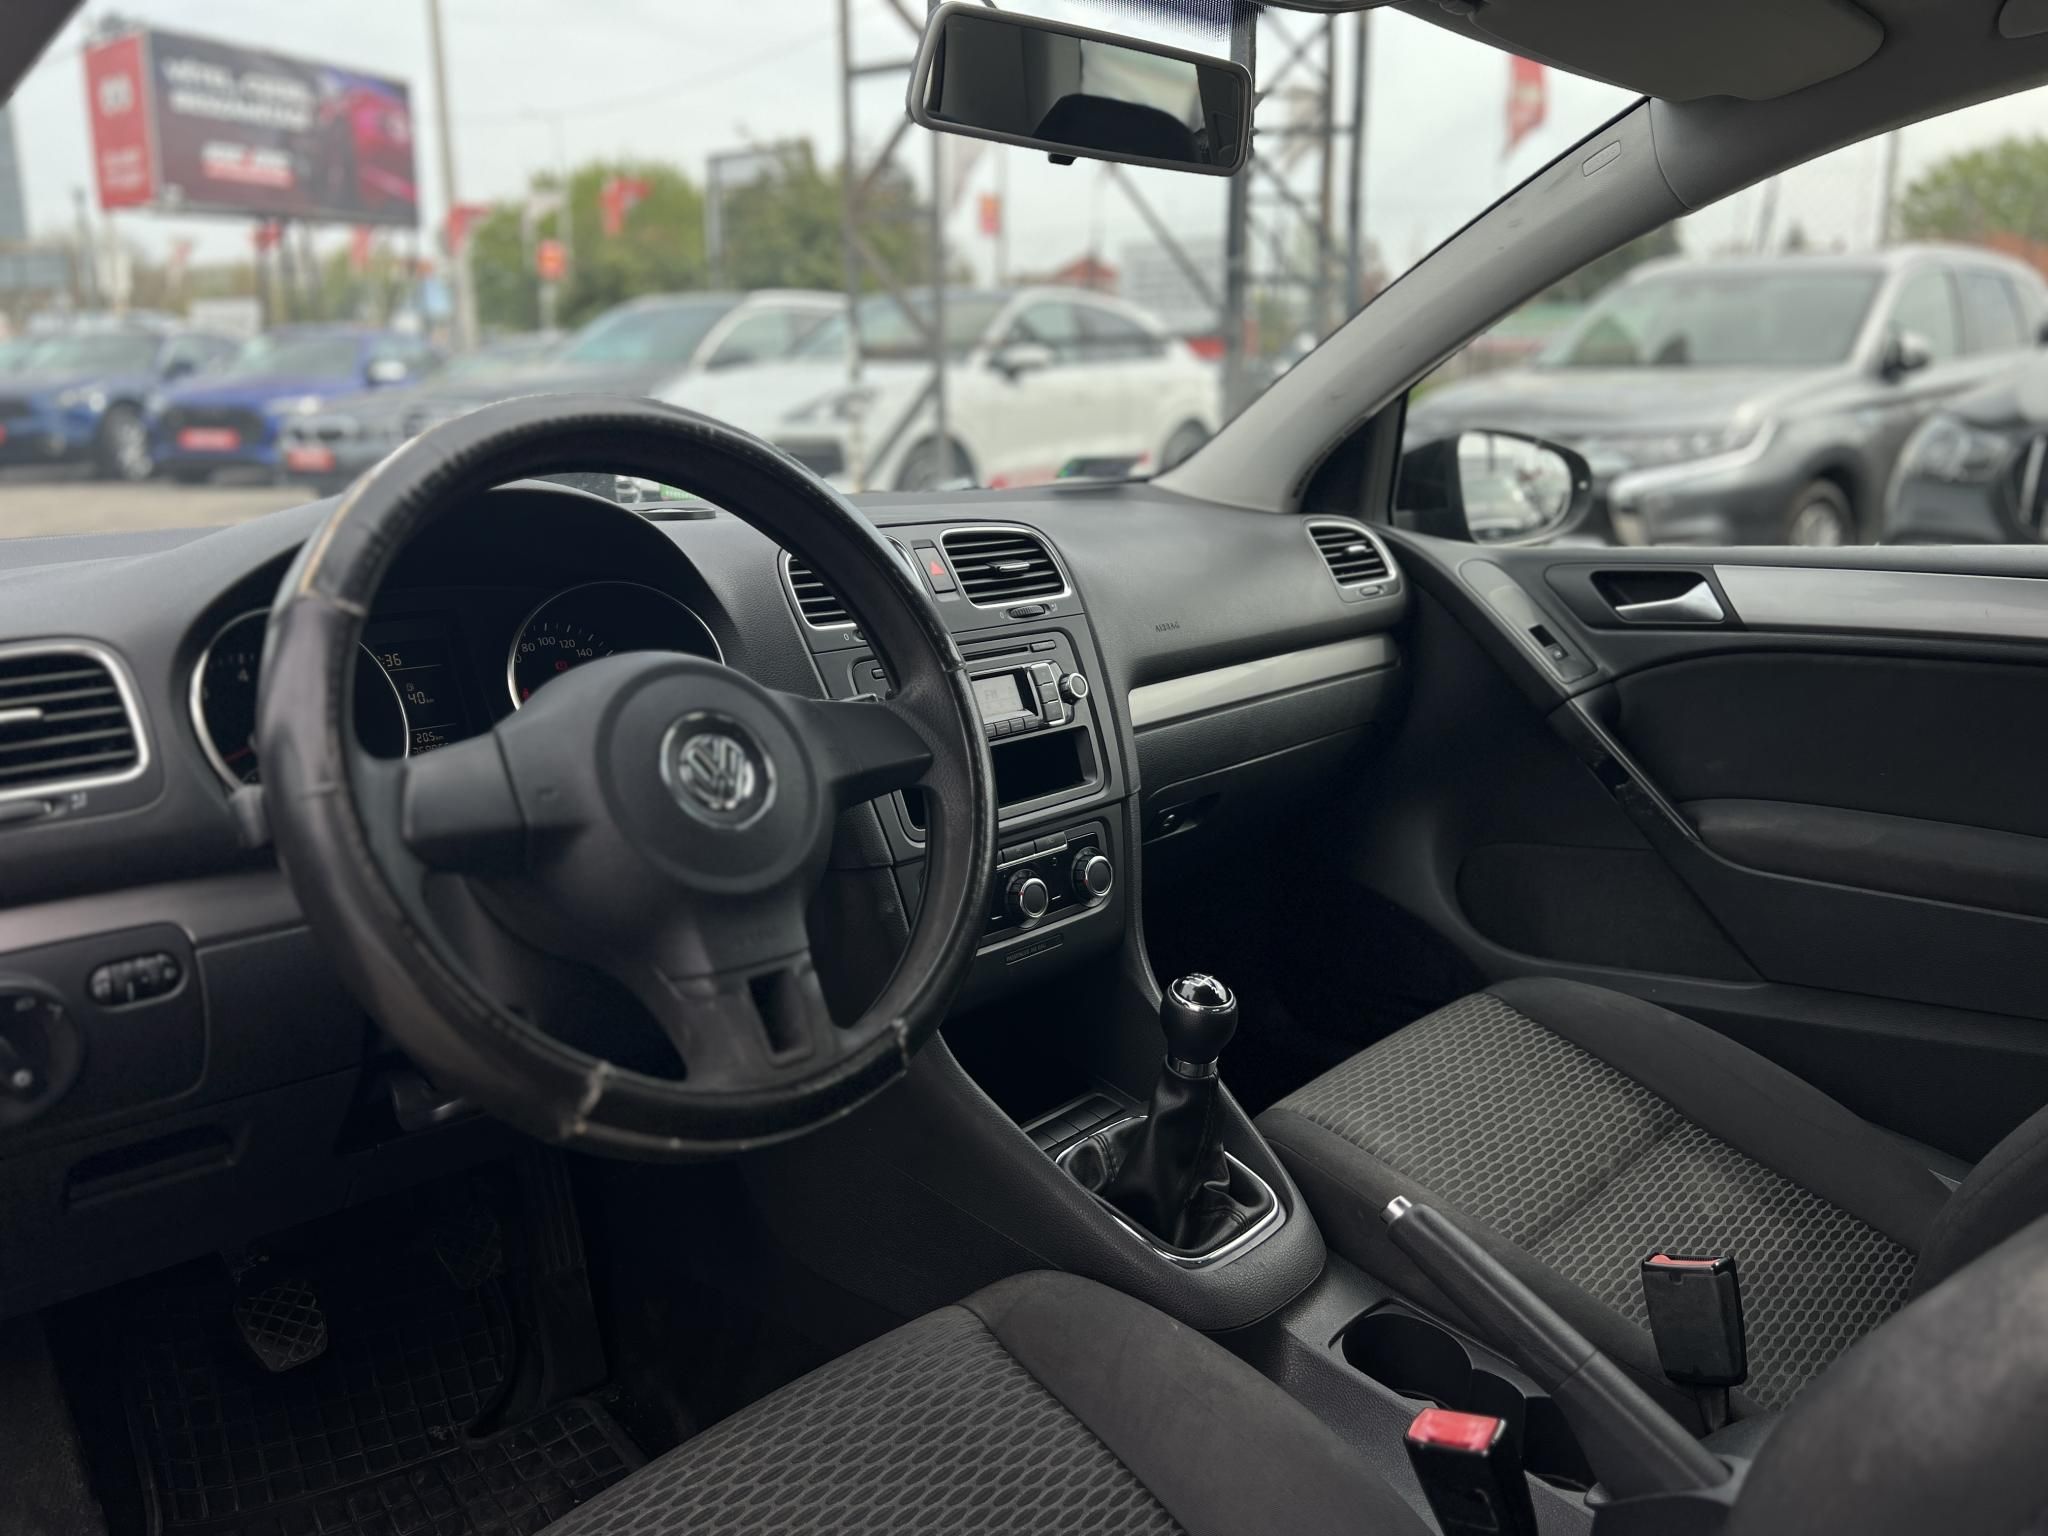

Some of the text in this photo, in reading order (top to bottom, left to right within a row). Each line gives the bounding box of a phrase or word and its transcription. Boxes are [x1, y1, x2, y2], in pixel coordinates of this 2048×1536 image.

[844, 633, 850, 641] 0
[521, 642, 536, 652] 80
[537, 636, 556, 646] 100
[559, 639, 576, 649] 120
[576, 647, 593, 657] 140
[408, 691, 426, 705] 40
